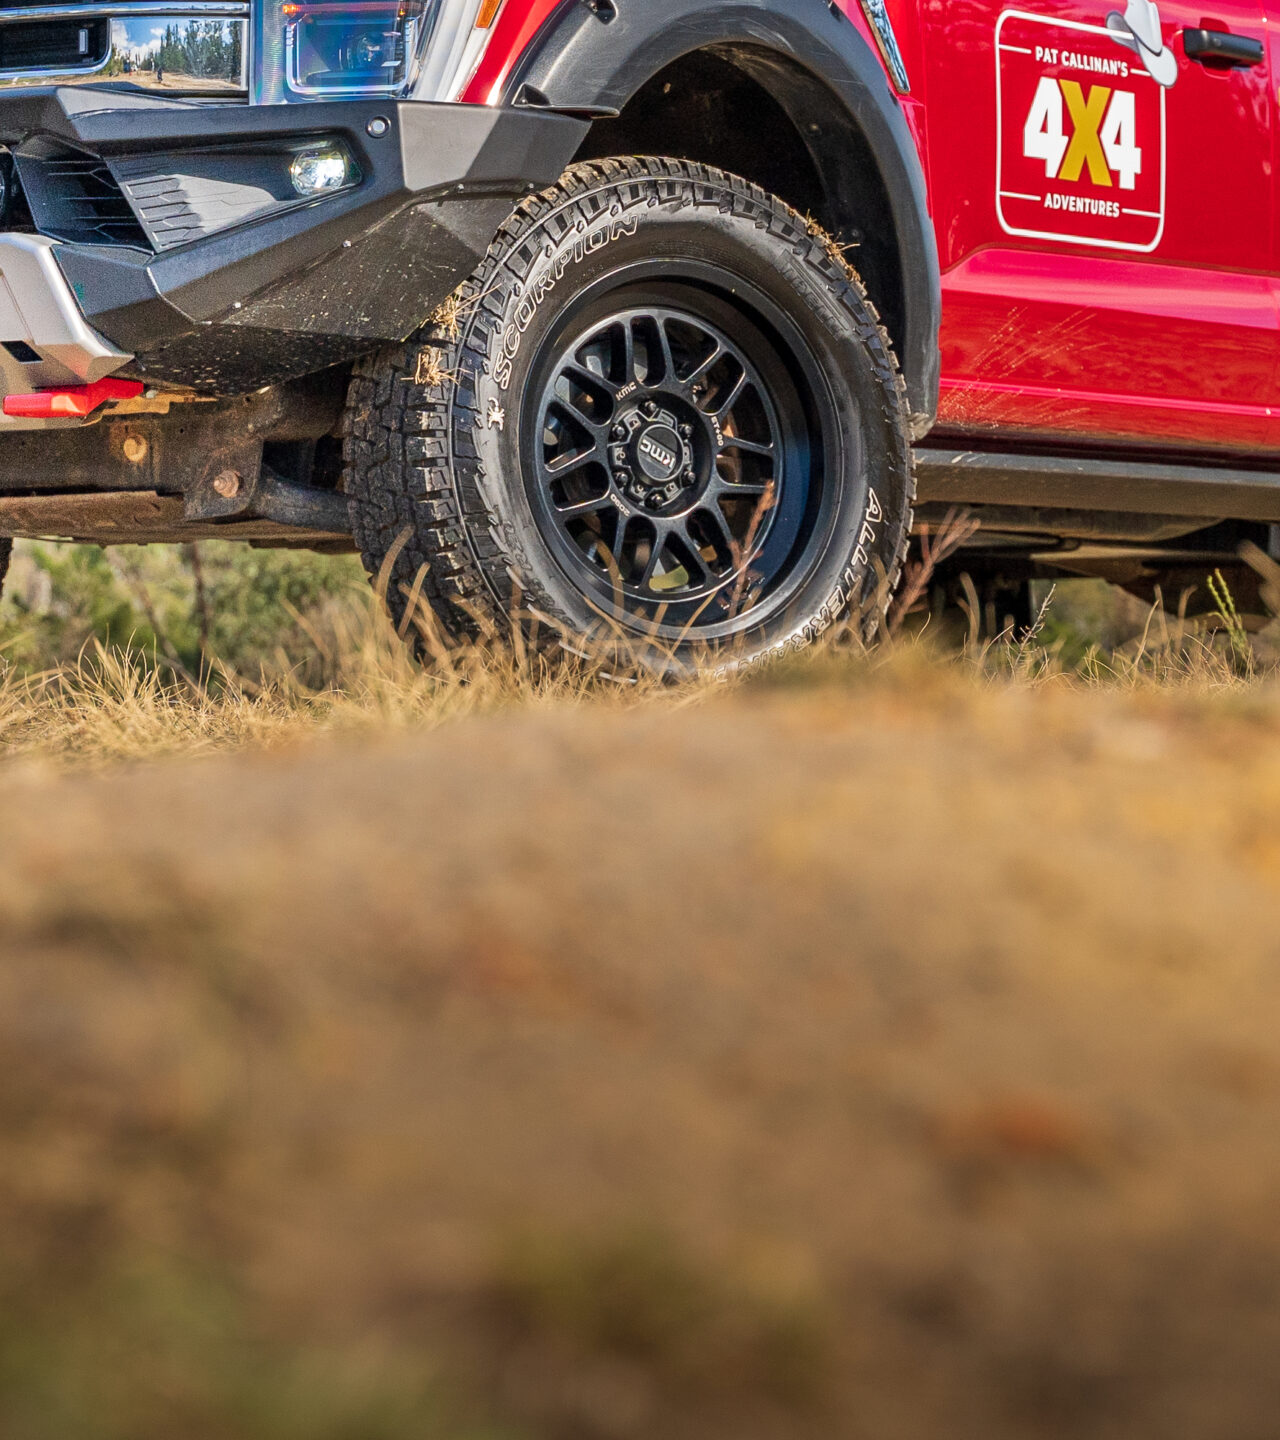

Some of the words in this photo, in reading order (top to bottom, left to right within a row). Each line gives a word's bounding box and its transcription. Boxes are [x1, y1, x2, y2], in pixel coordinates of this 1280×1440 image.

[1035, 46, 1058, 65] PAT
[1061, 51, 1128, 77] CALLINAN'S
[1023, 76, 1142, 191] 4X4
[1044, 192, 1120, 218] ADVENTURES
[492, 215, 639, 390] SCORPION
